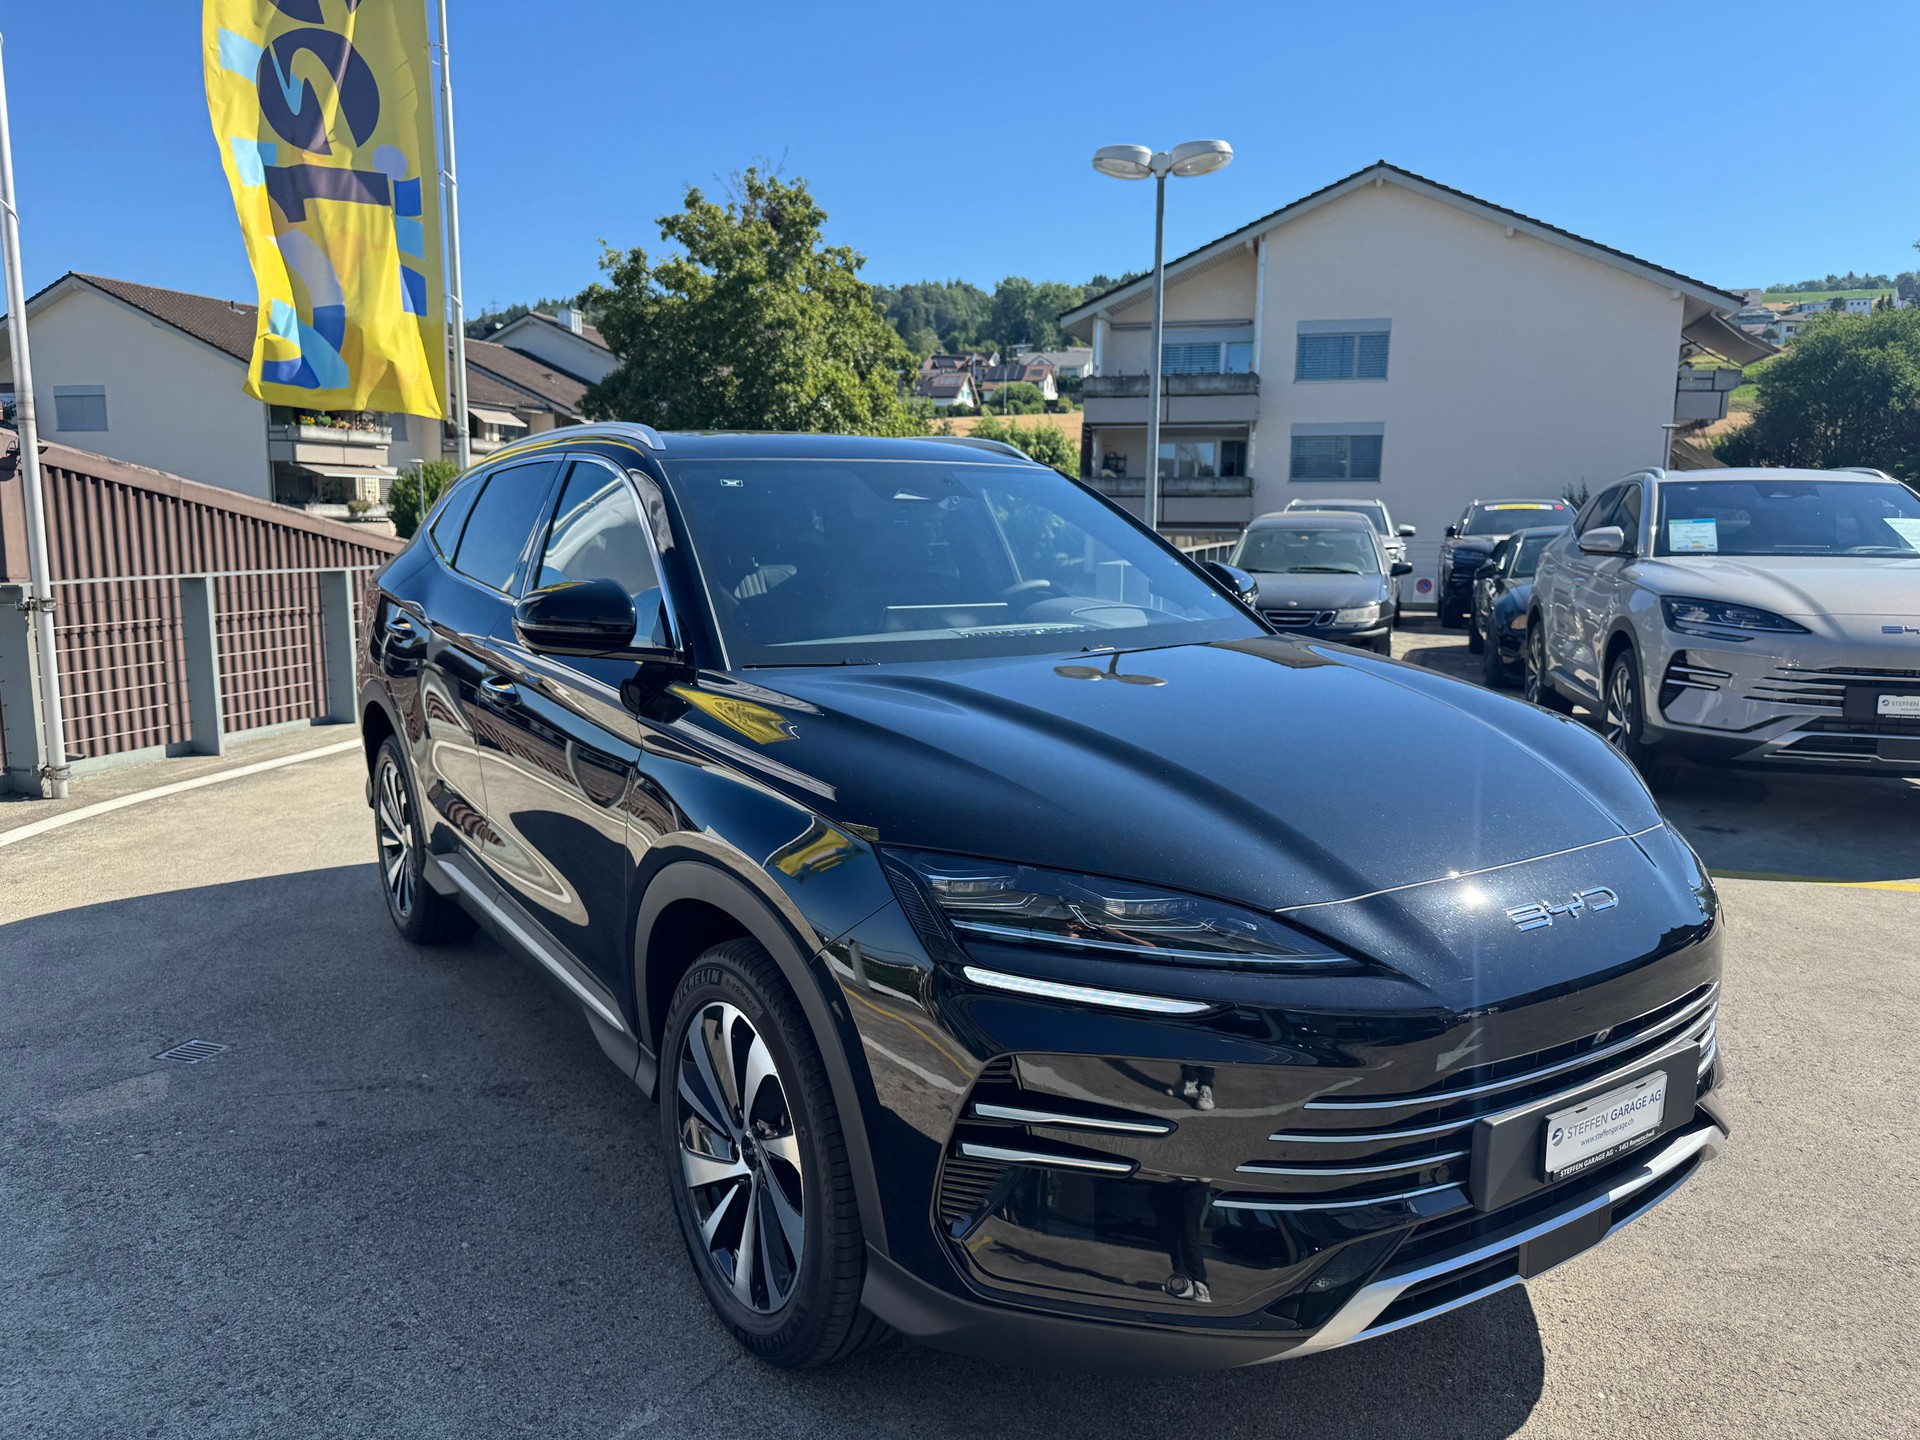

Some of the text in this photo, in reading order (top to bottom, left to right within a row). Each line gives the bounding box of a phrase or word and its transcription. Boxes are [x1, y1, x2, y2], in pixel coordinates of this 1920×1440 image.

[1503, 886, 1619, 933] BYD
[674, 969, 720, 1011] MICHELIN
[1567, 1089, 1662, 1140] STEFFEN GARAGE AG
[1580, 1117, 1635, 1146] www.steffengarage.ch
[1560, 1162, 1584, 1177] STEFFEN
[1583, 1152, 1606, 1167] GARAGE
[1605, 1148, 1614, 1158] AG
